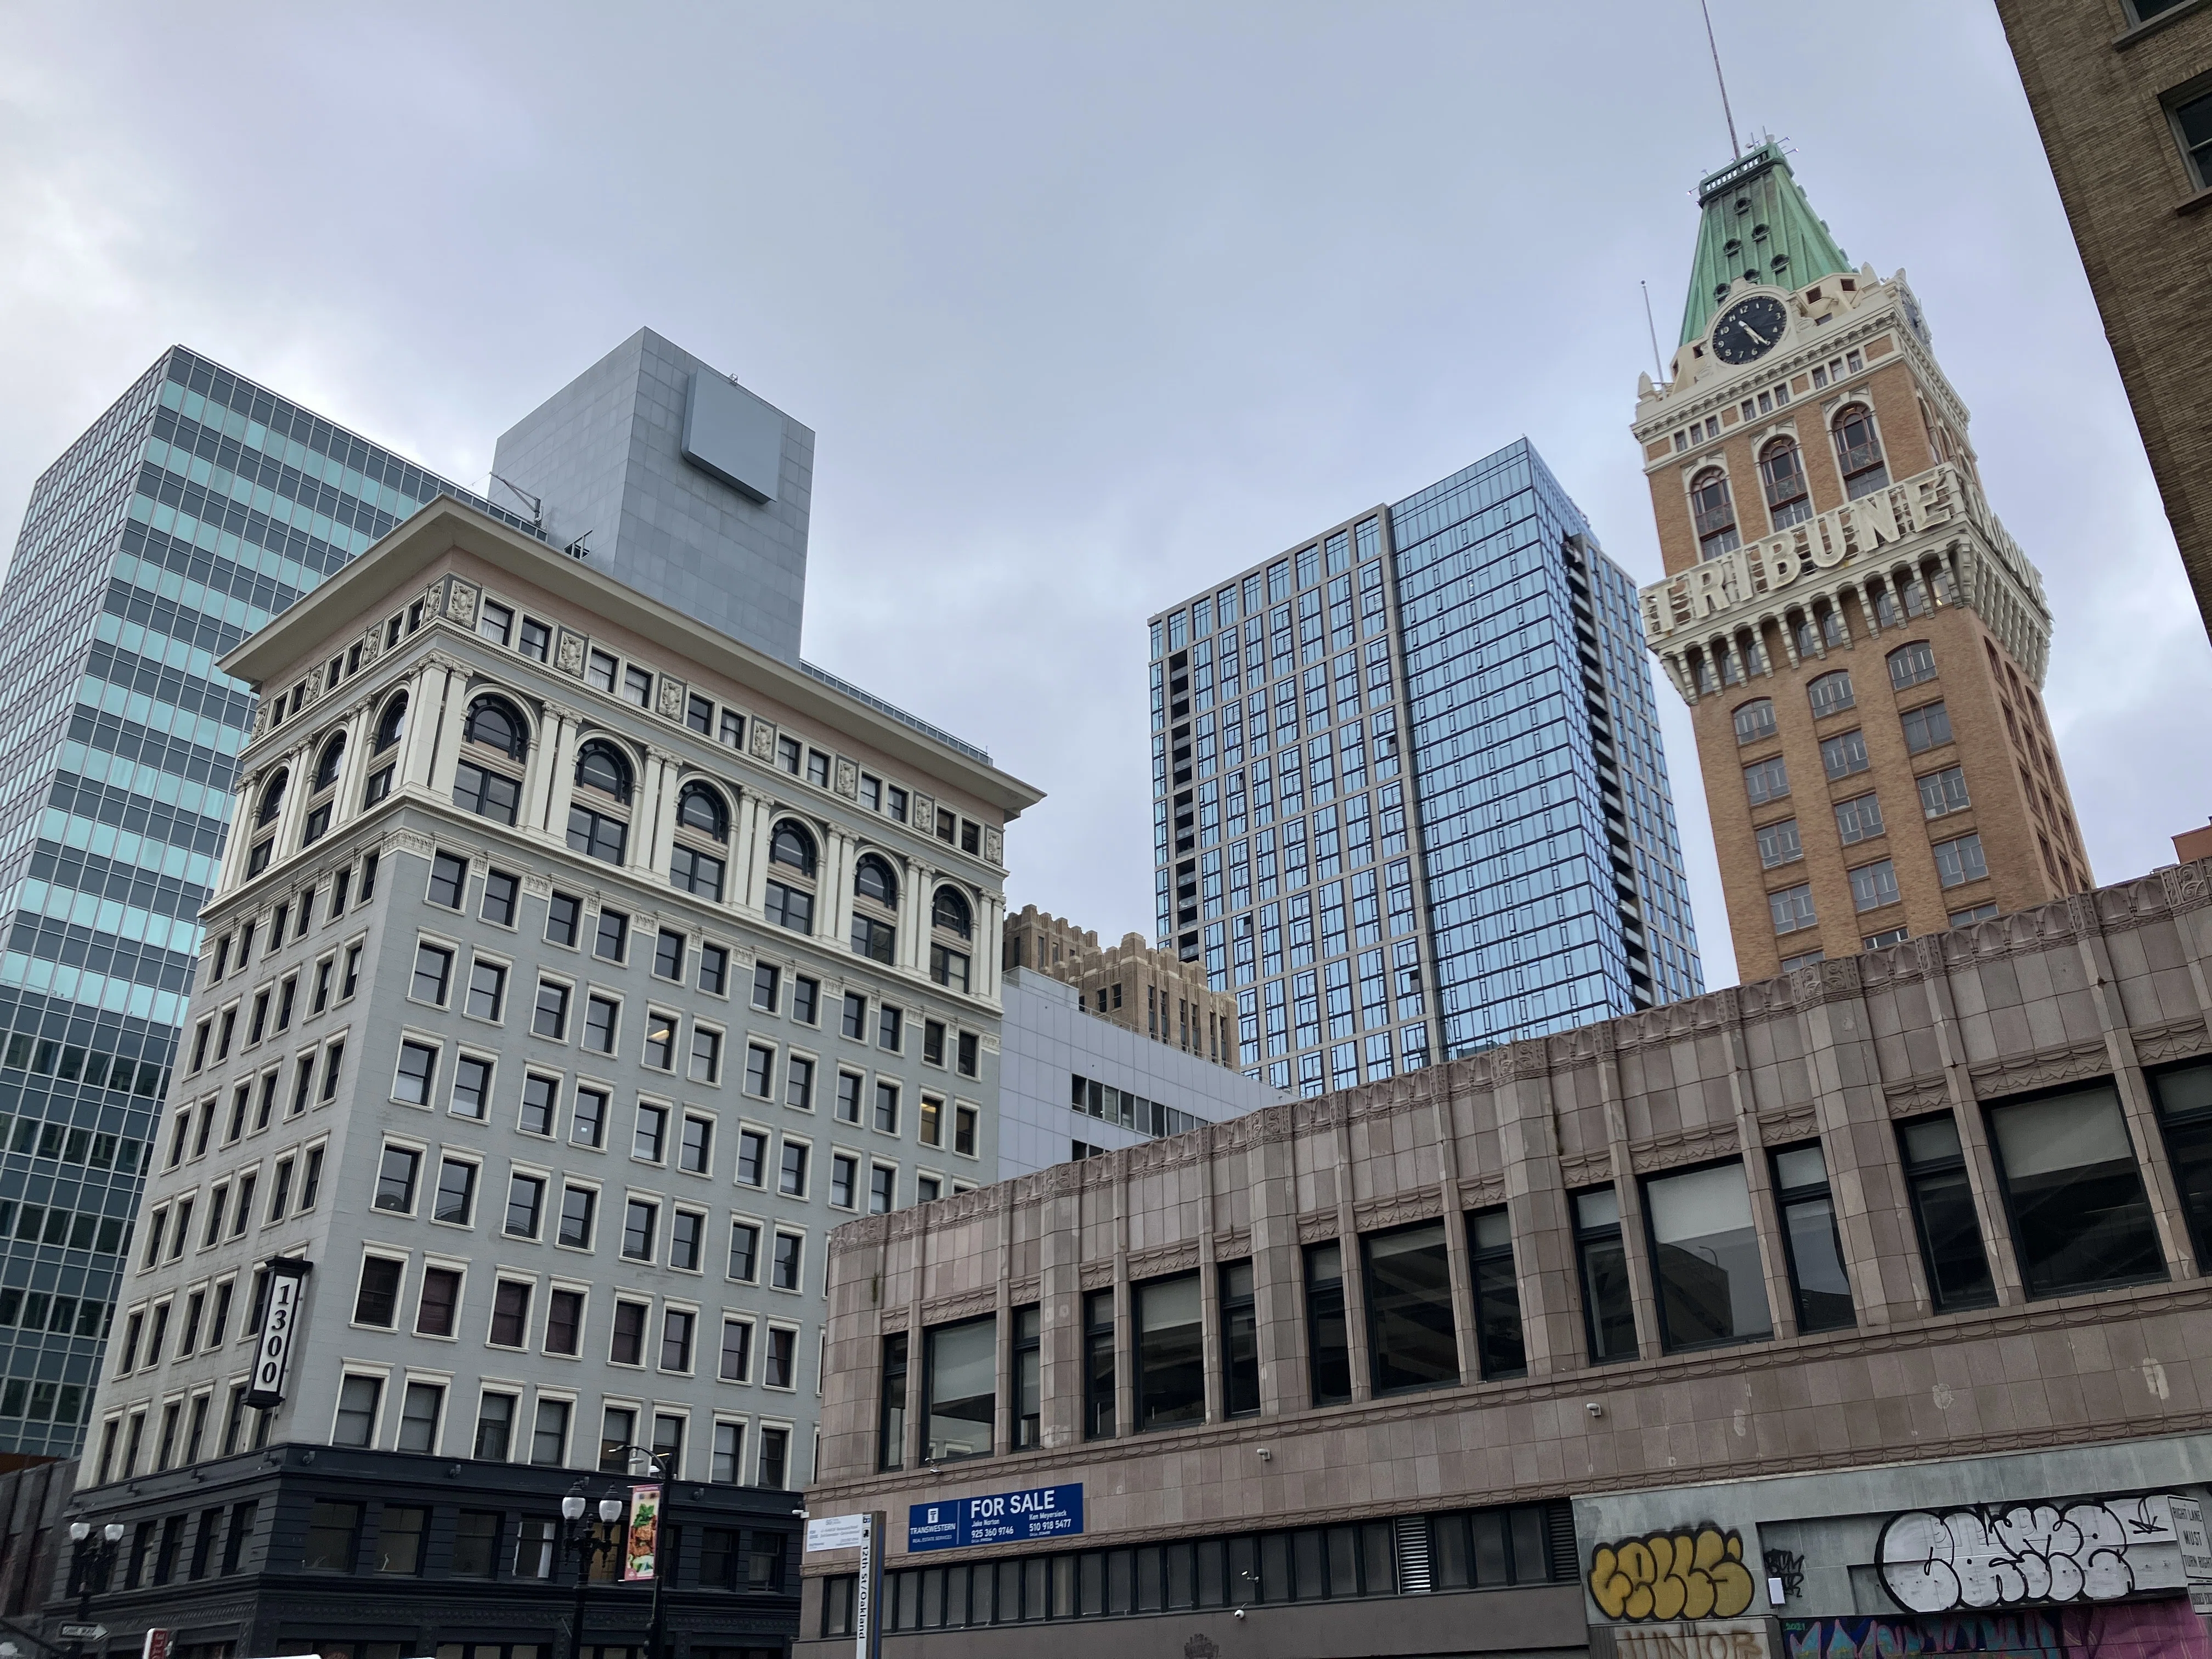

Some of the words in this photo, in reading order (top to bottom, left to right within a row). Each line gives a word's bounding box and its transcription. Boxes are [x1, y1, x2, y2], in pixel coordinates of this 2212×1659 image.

[1740, 305, 1748, 314] 12
[1775, 312, 1781, 320] 3
[1720, 326, 1730, 335] 10
[1739, 351, 1745, 359] 7
[1649, 466, 1951, 634] TRIBUNE
[262, 1284, 291, 1384] 1300
[970, 1497, 1005, 1519] FOR
[1009, 1489, 1055, 1514] SALE
[910, 1522, 956, 1534] TRANSWESTERN
[1029, 1522, 1041, 1532] 510
[1042, 1520, 1054, 1530] 918
[1055, 1518, 1072, 1529] 5477
[971, 1530, 983, 1538] 925
[984, 1528, 997, 1537] 360
[998, 1526, 1014, 1536] 9746
[2182, 1530, 2202, 1546] MUST
